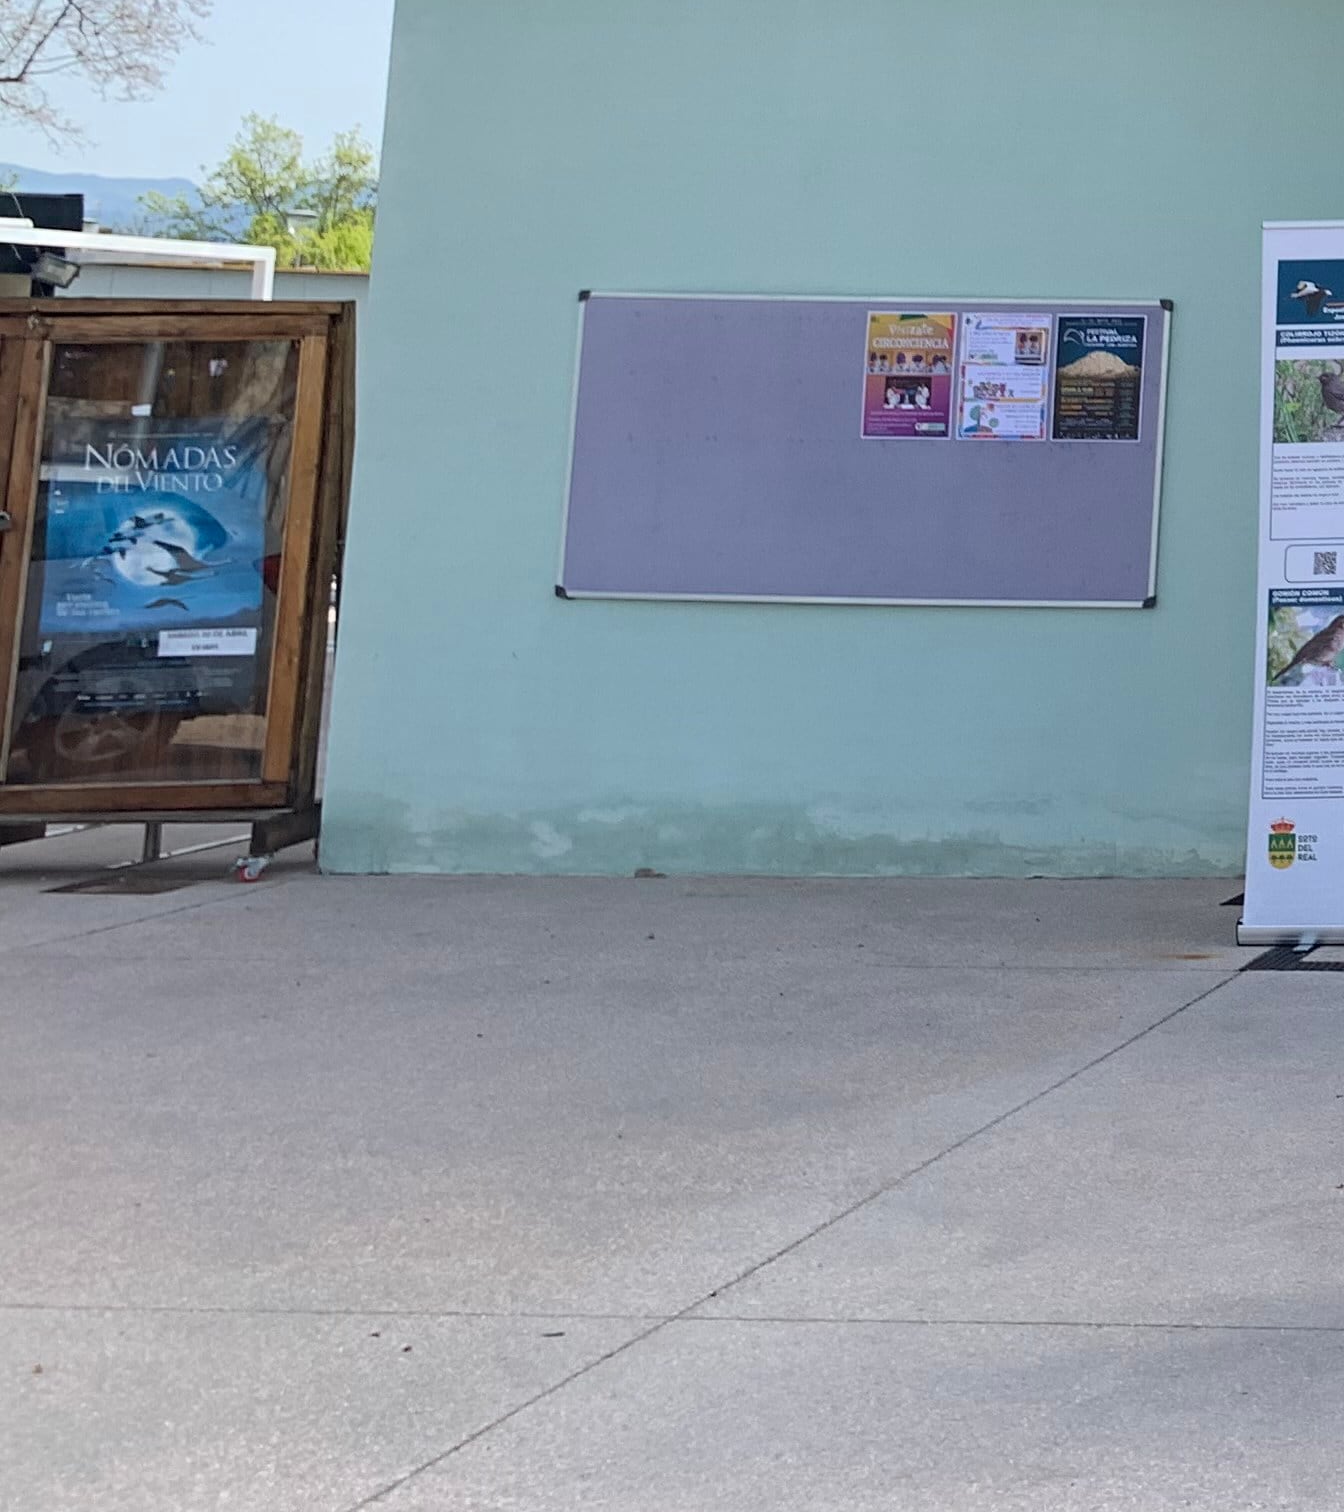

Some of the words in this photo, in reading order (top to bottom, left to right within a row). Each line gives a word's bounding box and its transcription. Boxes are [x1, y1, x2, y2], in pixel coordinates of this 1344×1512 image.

[85, 443, 237, 471] NÓMADAS
[97, 474, 135, 493] DEL
[136, 470, 223, 493] VIENTO
[1297, 844, 1313, 852] DEL
[1297, 853, 1318, 862] REAL
